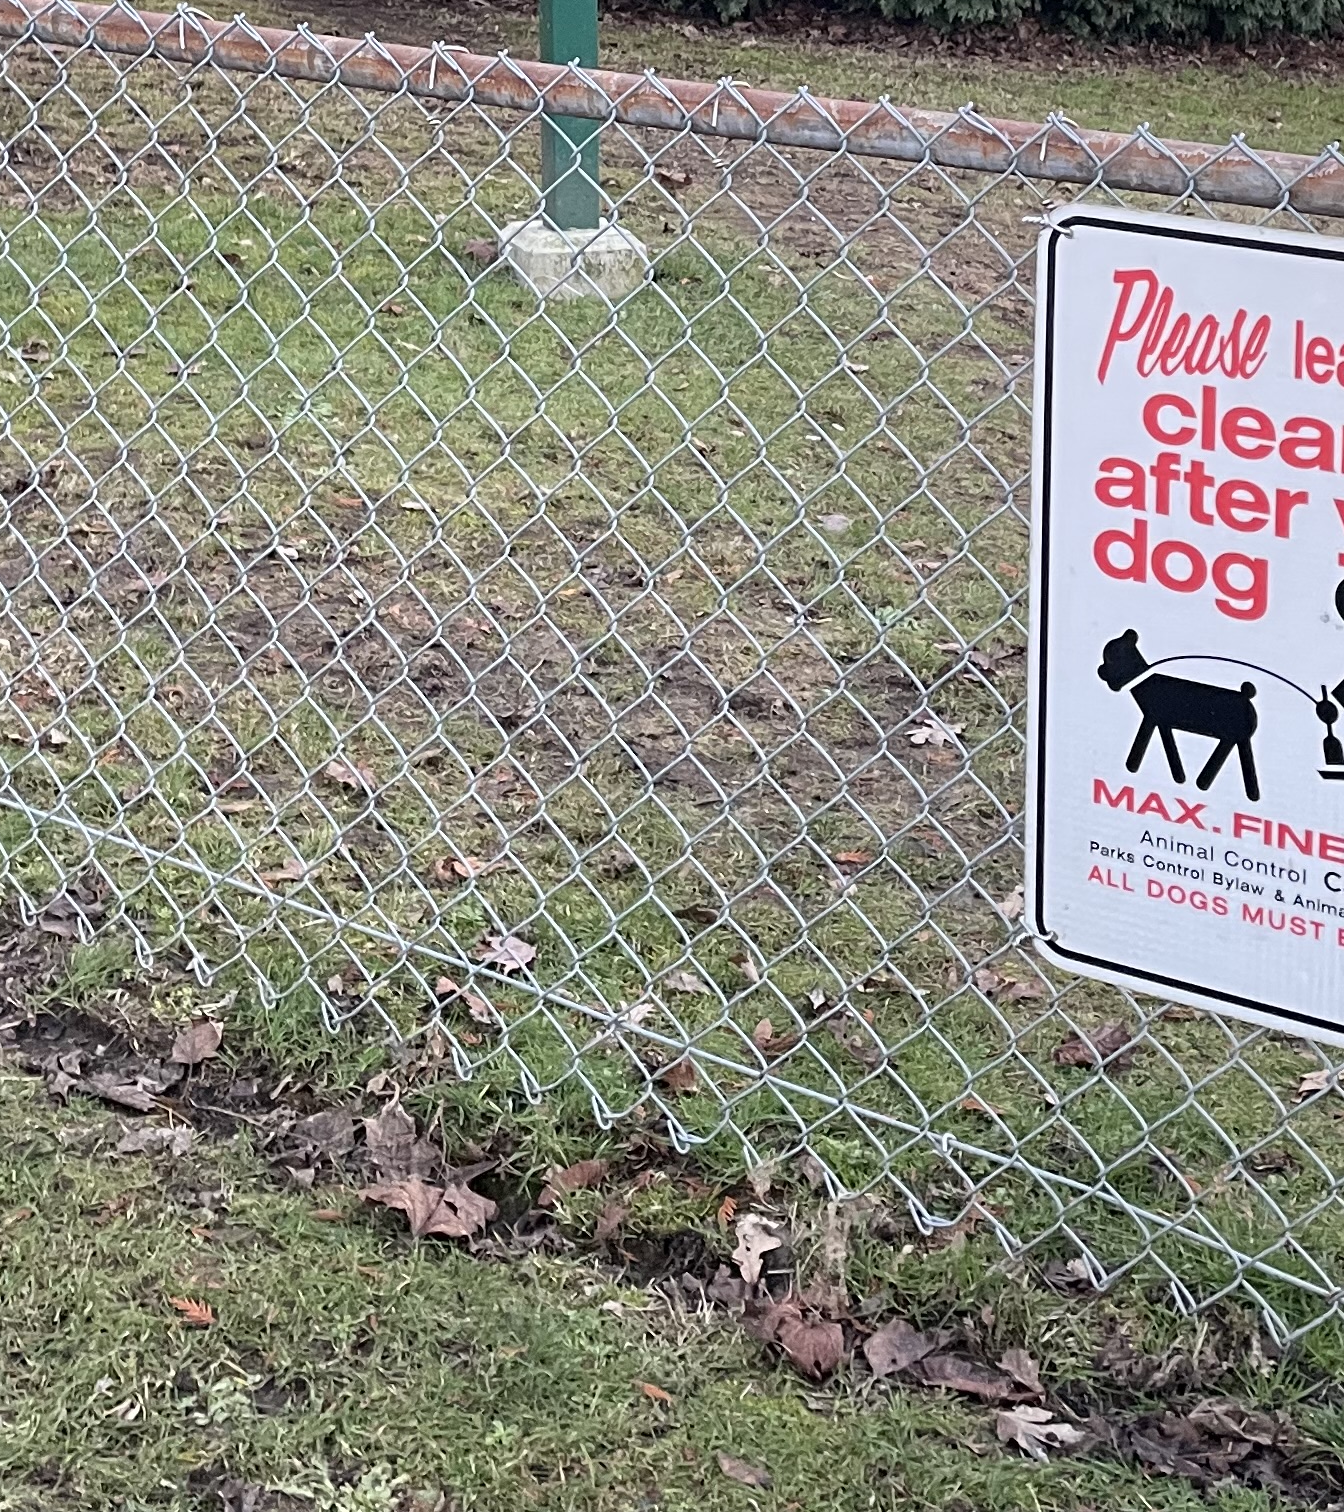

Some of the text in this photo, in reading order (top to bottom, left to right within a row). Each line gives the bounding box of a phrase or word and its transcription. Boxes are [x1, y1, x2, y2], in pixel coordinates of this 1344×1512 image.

[1097, 268, 1271, 386] Please
[1094, 451, 1308, 539] after
[1092, 517, 1269, 620] dog
[1092, 778, 1222, 834] MAX.
[1089, 840, 1135, 864] Parks
[1142, 855, 1205, 882] Control
[1212, 871, 1264, 896] Bylaw
[1274, 889, 1285, 902] &
[1140, 829, 1214, 862] Animal
[1224, 850, 1308, 885] Control
[1087, 864, 1135, 893] ALL
[1147, 879, 1229, 916] DOGS
[1242, 903, 1326, 941] MUST
